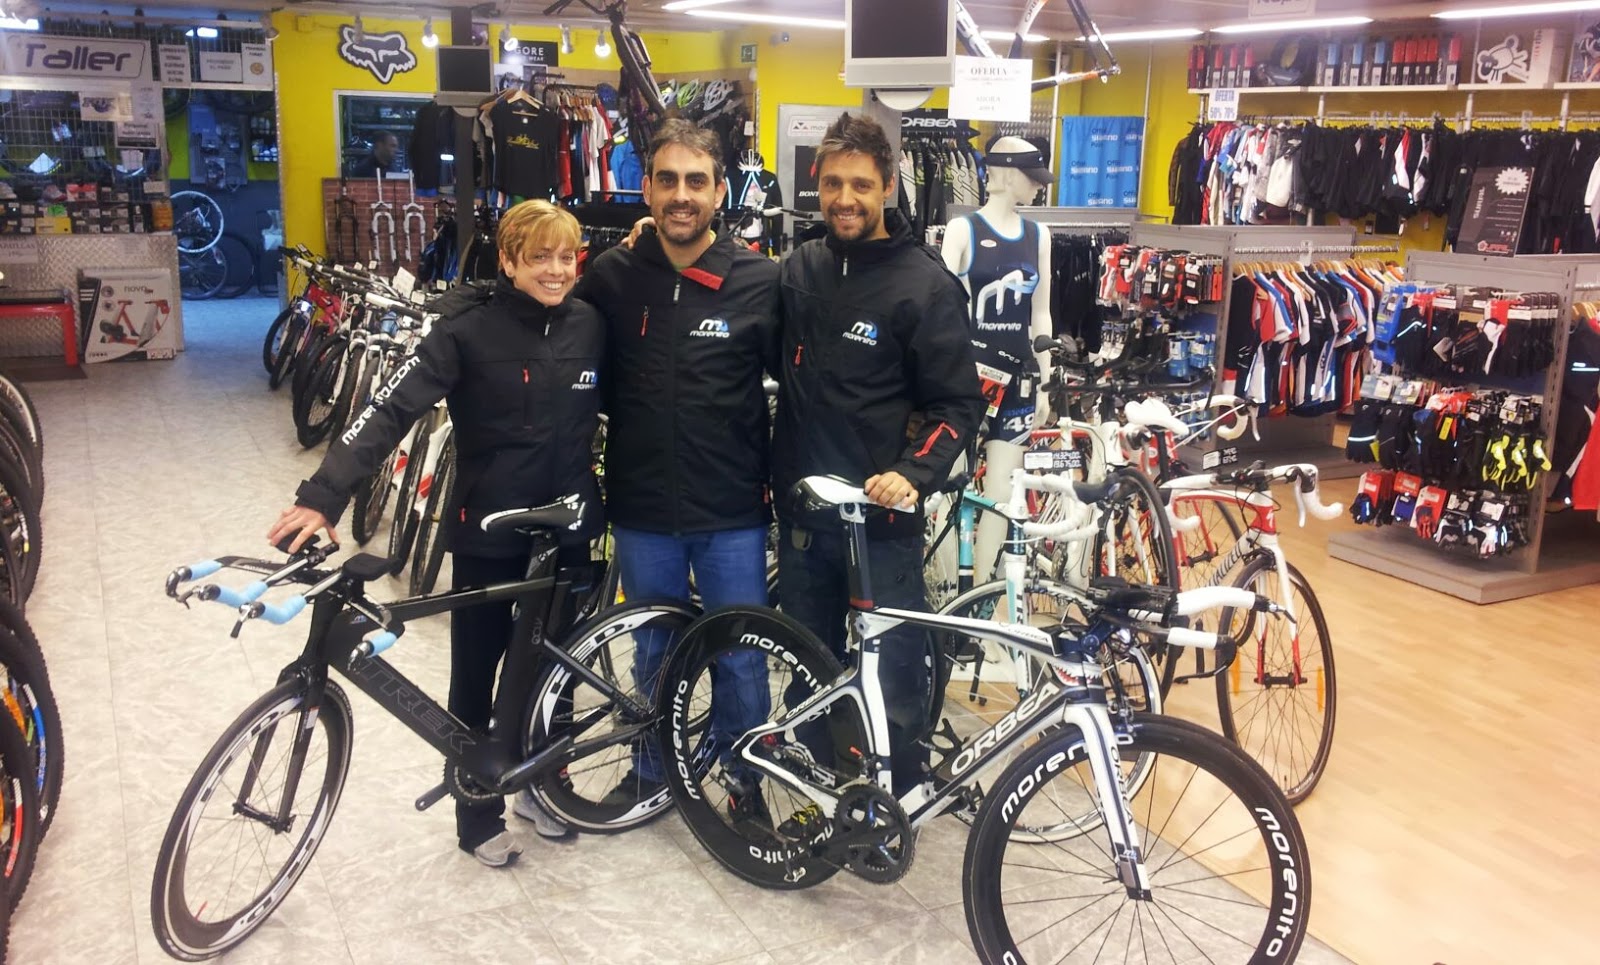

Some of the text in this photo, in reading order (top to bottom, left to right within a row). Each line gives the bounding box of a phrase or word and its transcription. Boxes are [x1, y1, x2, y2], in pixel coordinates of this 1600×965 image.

[26, 43, 131, 71] Taller
[515, 46, 545, 56] GORE
[970, 67, 1007, 76] OFERTA
[901, 116, 957, 128] ORBEA
[689, 330, 730, 338] morenito
[977, 322, 1022, 331] morenito
[842, 331, 877, 346] morenito
[361, 655, 477, 755] TREK
[951, 681, 1061, 776] ORBEA
[672, 679, 701, 800] morenito
[1255, 806, 1299, 957] morenito
